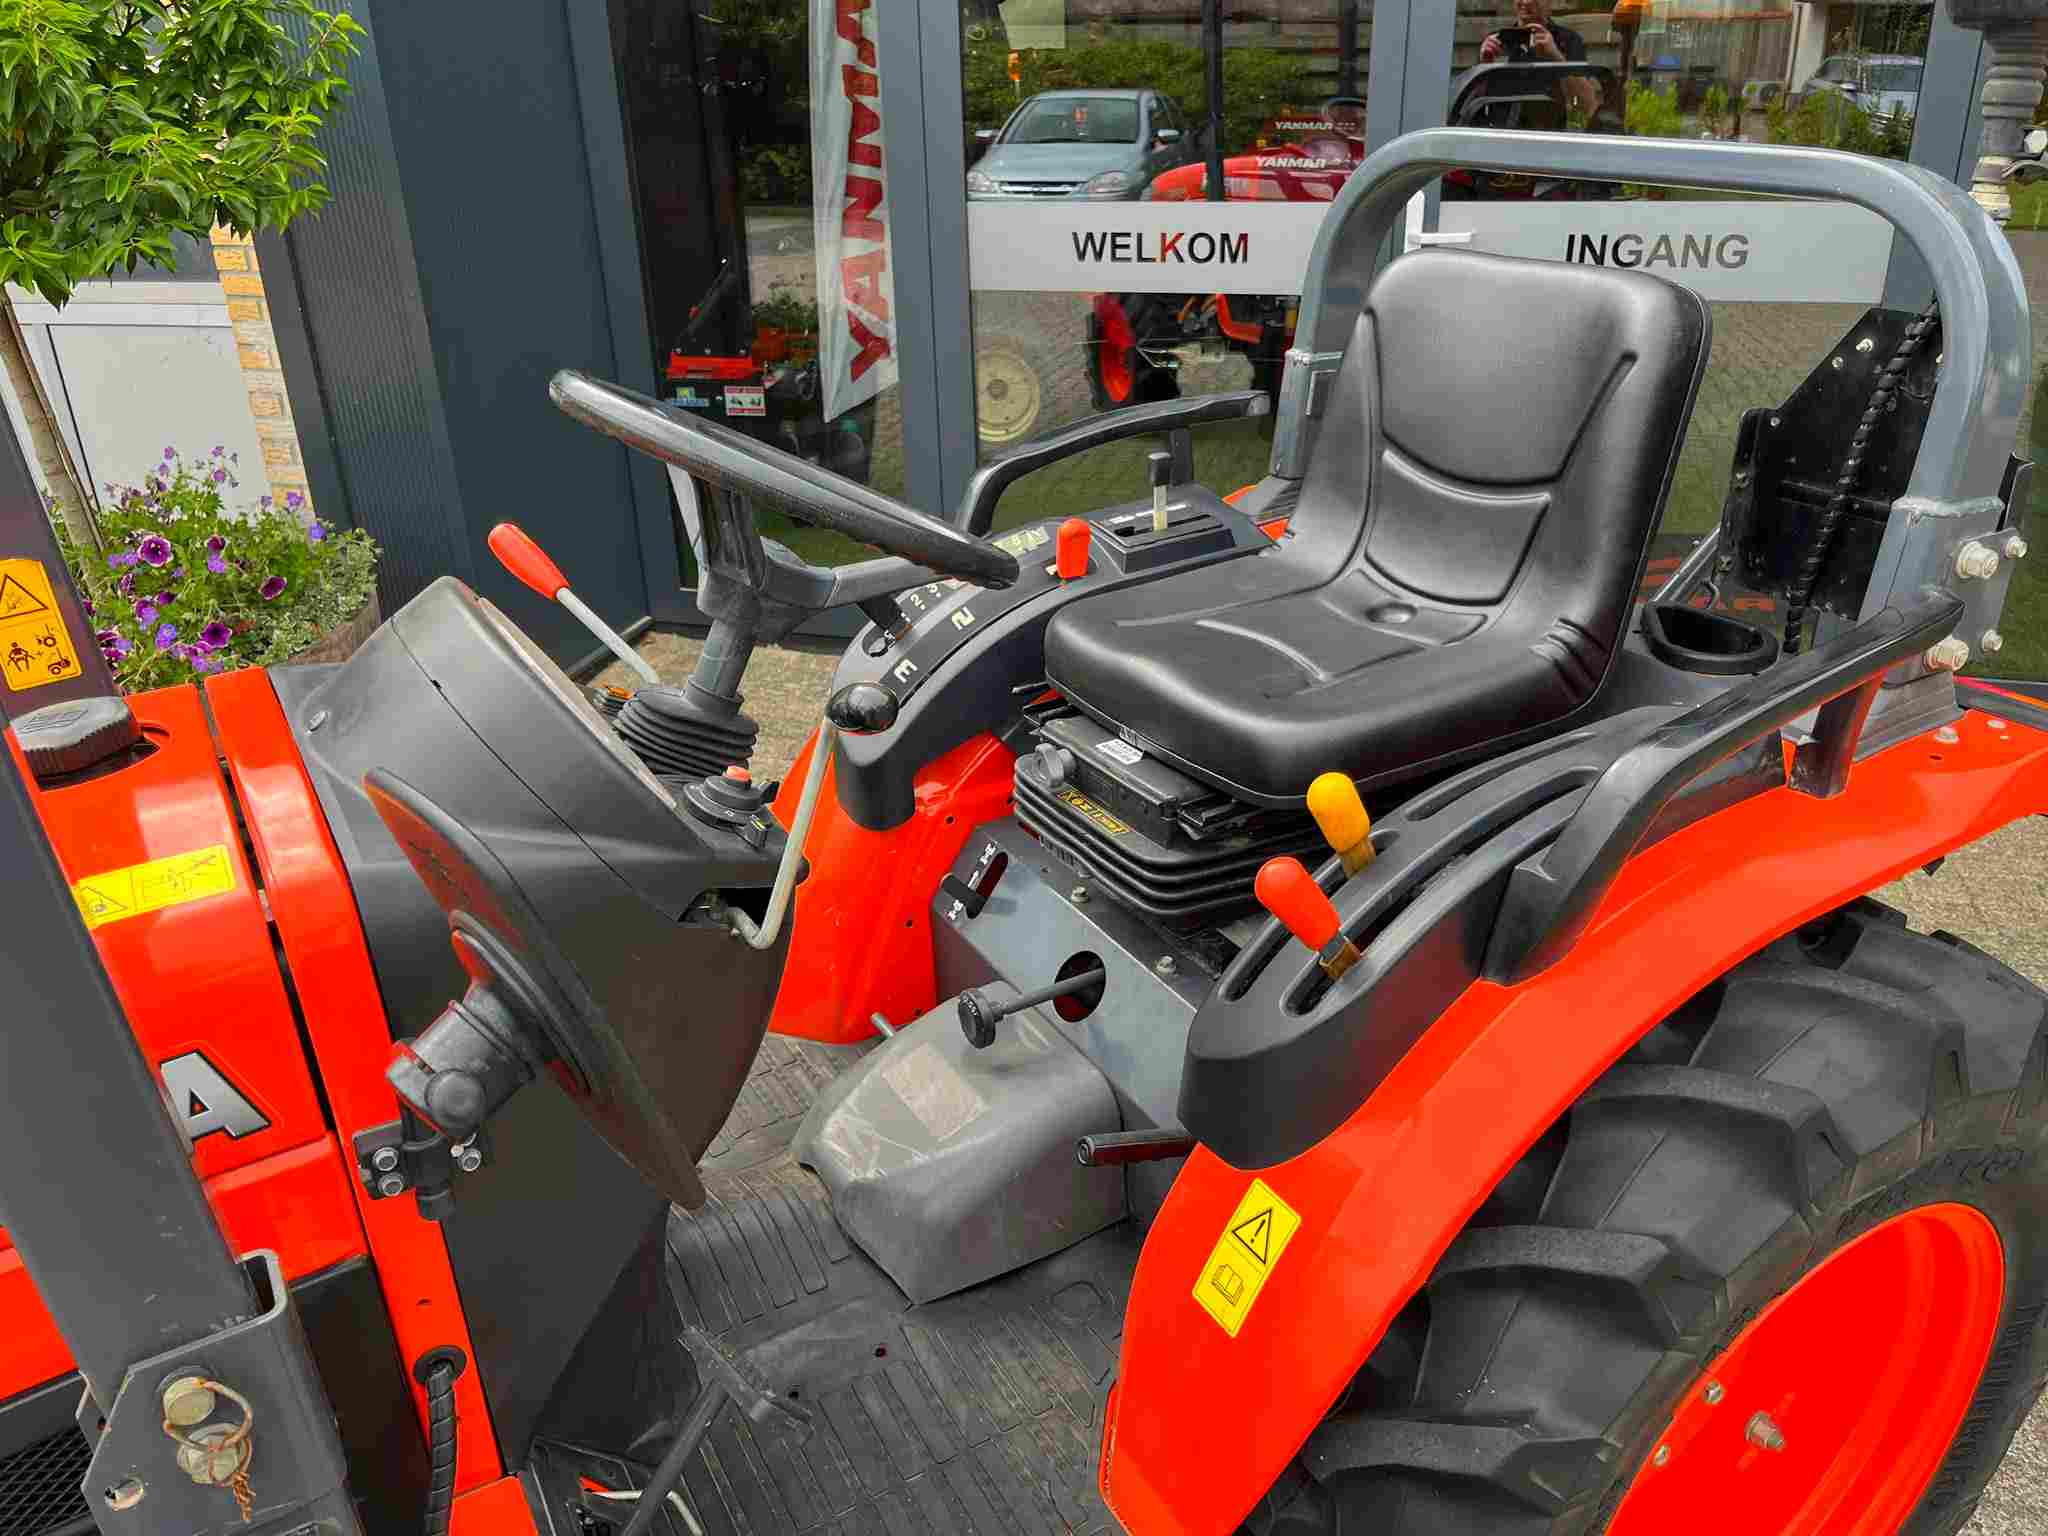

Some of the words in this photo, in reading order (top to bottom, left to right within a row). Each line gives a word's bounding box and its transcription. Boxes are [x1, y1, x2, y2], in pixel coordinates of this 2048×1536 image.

[1256, 156, 1327, 168] YANMAR
[1072, 231, 1249, 264] WELKOM
[1565, 233, 1749, 269] INGANG
